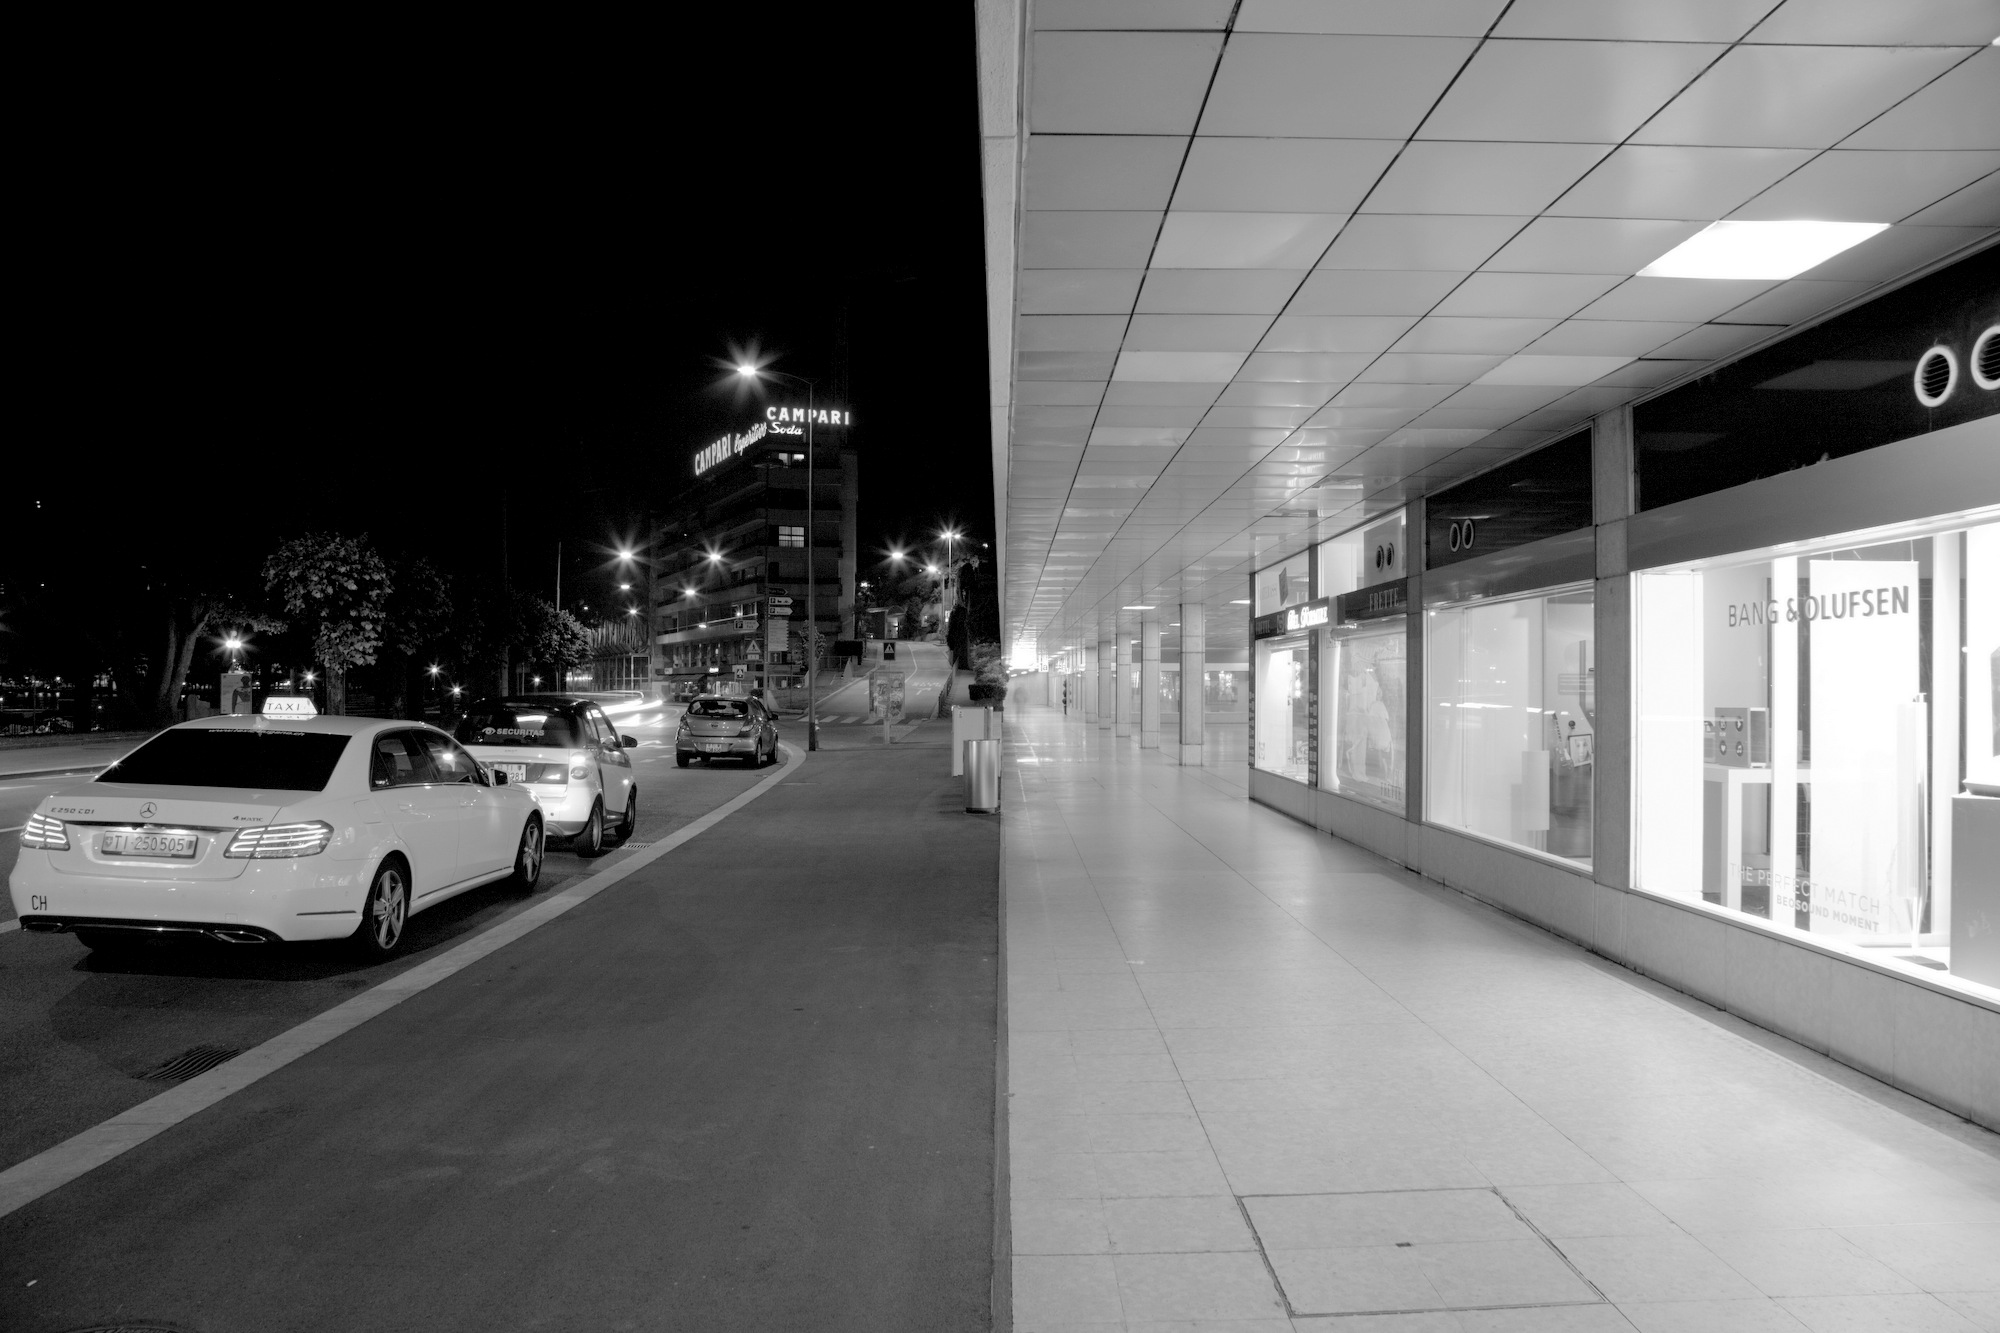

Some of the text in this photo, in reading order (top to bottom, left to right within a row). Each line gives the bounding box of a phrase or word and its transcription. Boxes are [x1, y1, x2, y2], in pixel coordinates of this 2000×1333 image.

[766, 406, 850, 425] CAMPARI
[767, 421, 804, 435] Soda
[694, 433, 731, 476] CAMPARI
[1728, 585, 1910, 627] BANG & OLUFSEN
[266, 702, 300, 711] TAXI
[496, 728, 545, 736] SECURITAS
[1729, 863, 1880, 916] THE PERFECT MATCH
[31, 895, 47, 911] CH
[1776, 894, 1880, 933] BEOSOUND MOMENT
